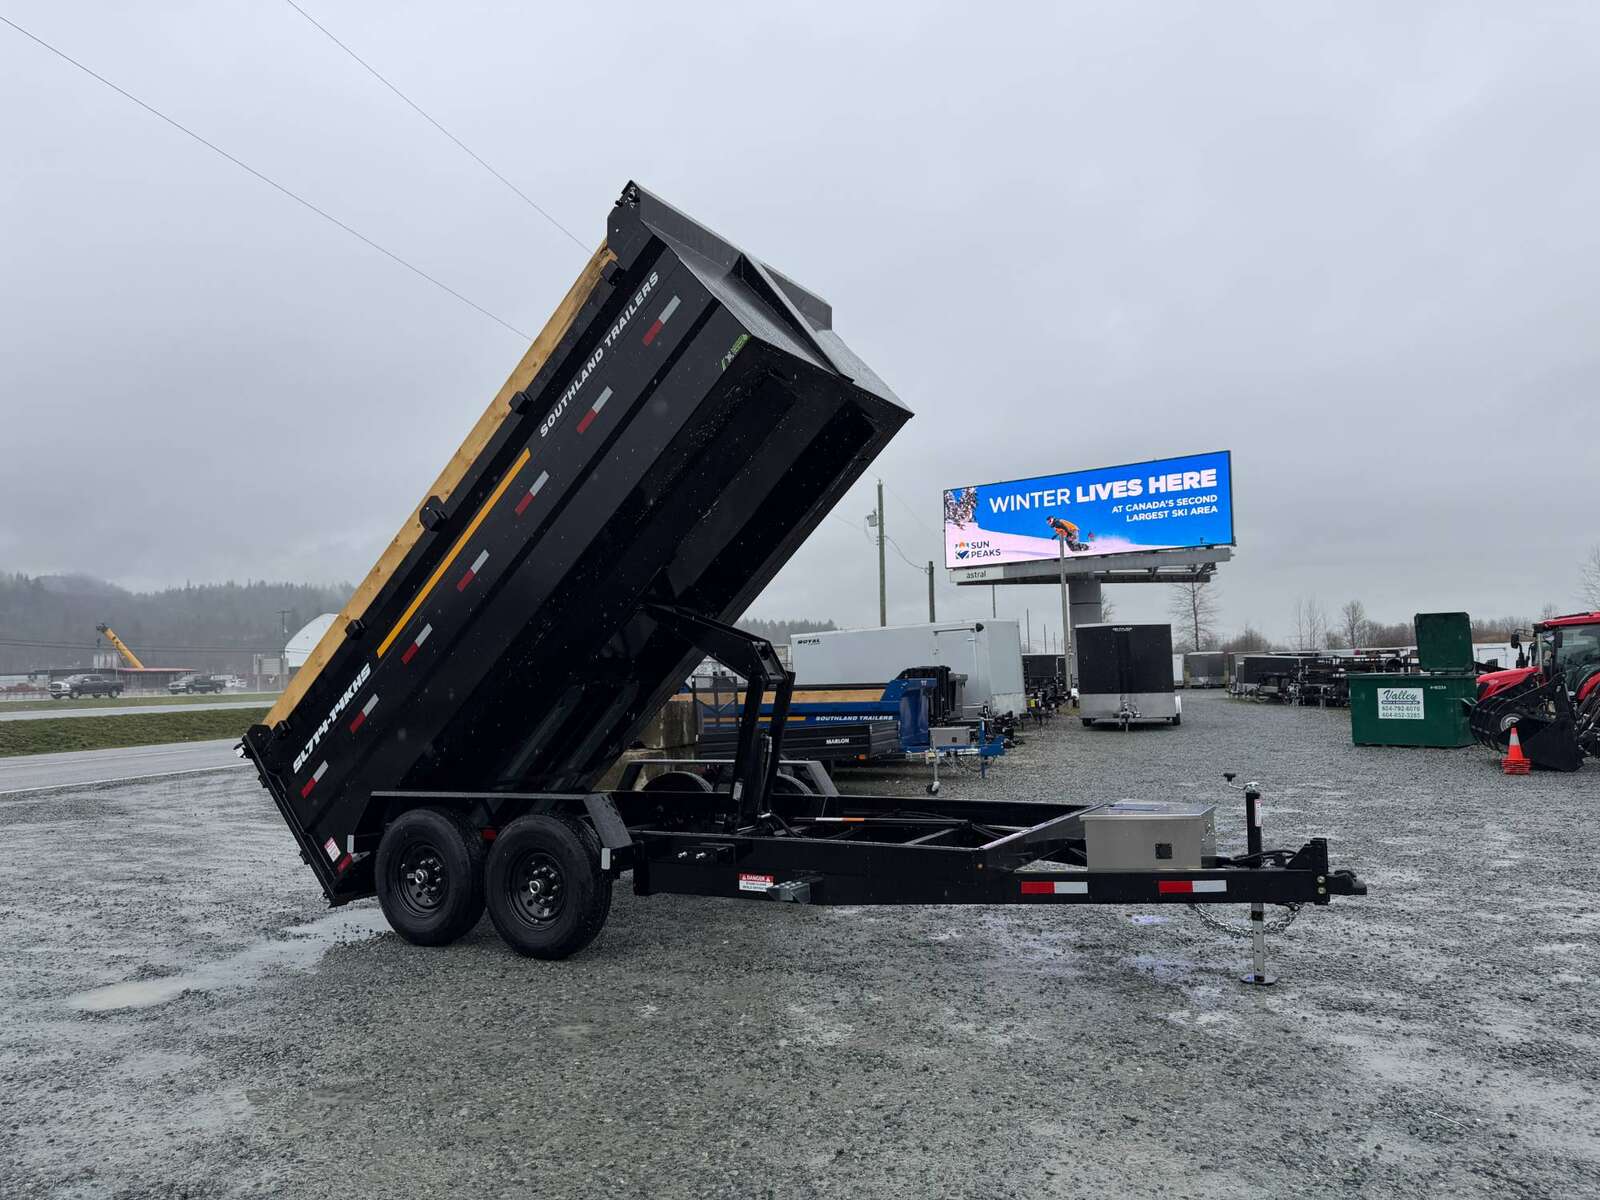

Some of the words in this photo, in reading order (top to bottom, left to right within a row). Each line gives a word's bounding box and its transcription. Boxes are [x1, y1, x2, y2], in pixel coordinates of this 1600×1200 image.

[540, 347, 604, 437] SOUTHLAND
[604, 271, 660, 347] TRAILERS
[989, 487, 1072, 514] WINTER
[1076, 478, 1143, 503] LIVES
[1148, 468, 1217, 495] HERE
[1111, 504, 1123, 514] AT
[1125, 499, 1174, 512] CANADA'S
[1176, 494, 1218, 506] SECOND
[1126, 510, 1169, 522] LARGEST
[1171, 507, 1188, 518] SKI
[1190, 504, 1218, 516] AREA
[970, 540, 990, 549] SUN
[971, 548, 1001, 558] PEAKS
[966, 570, 987, 579] astral
[1383, 690, 1417, 702] Valley
